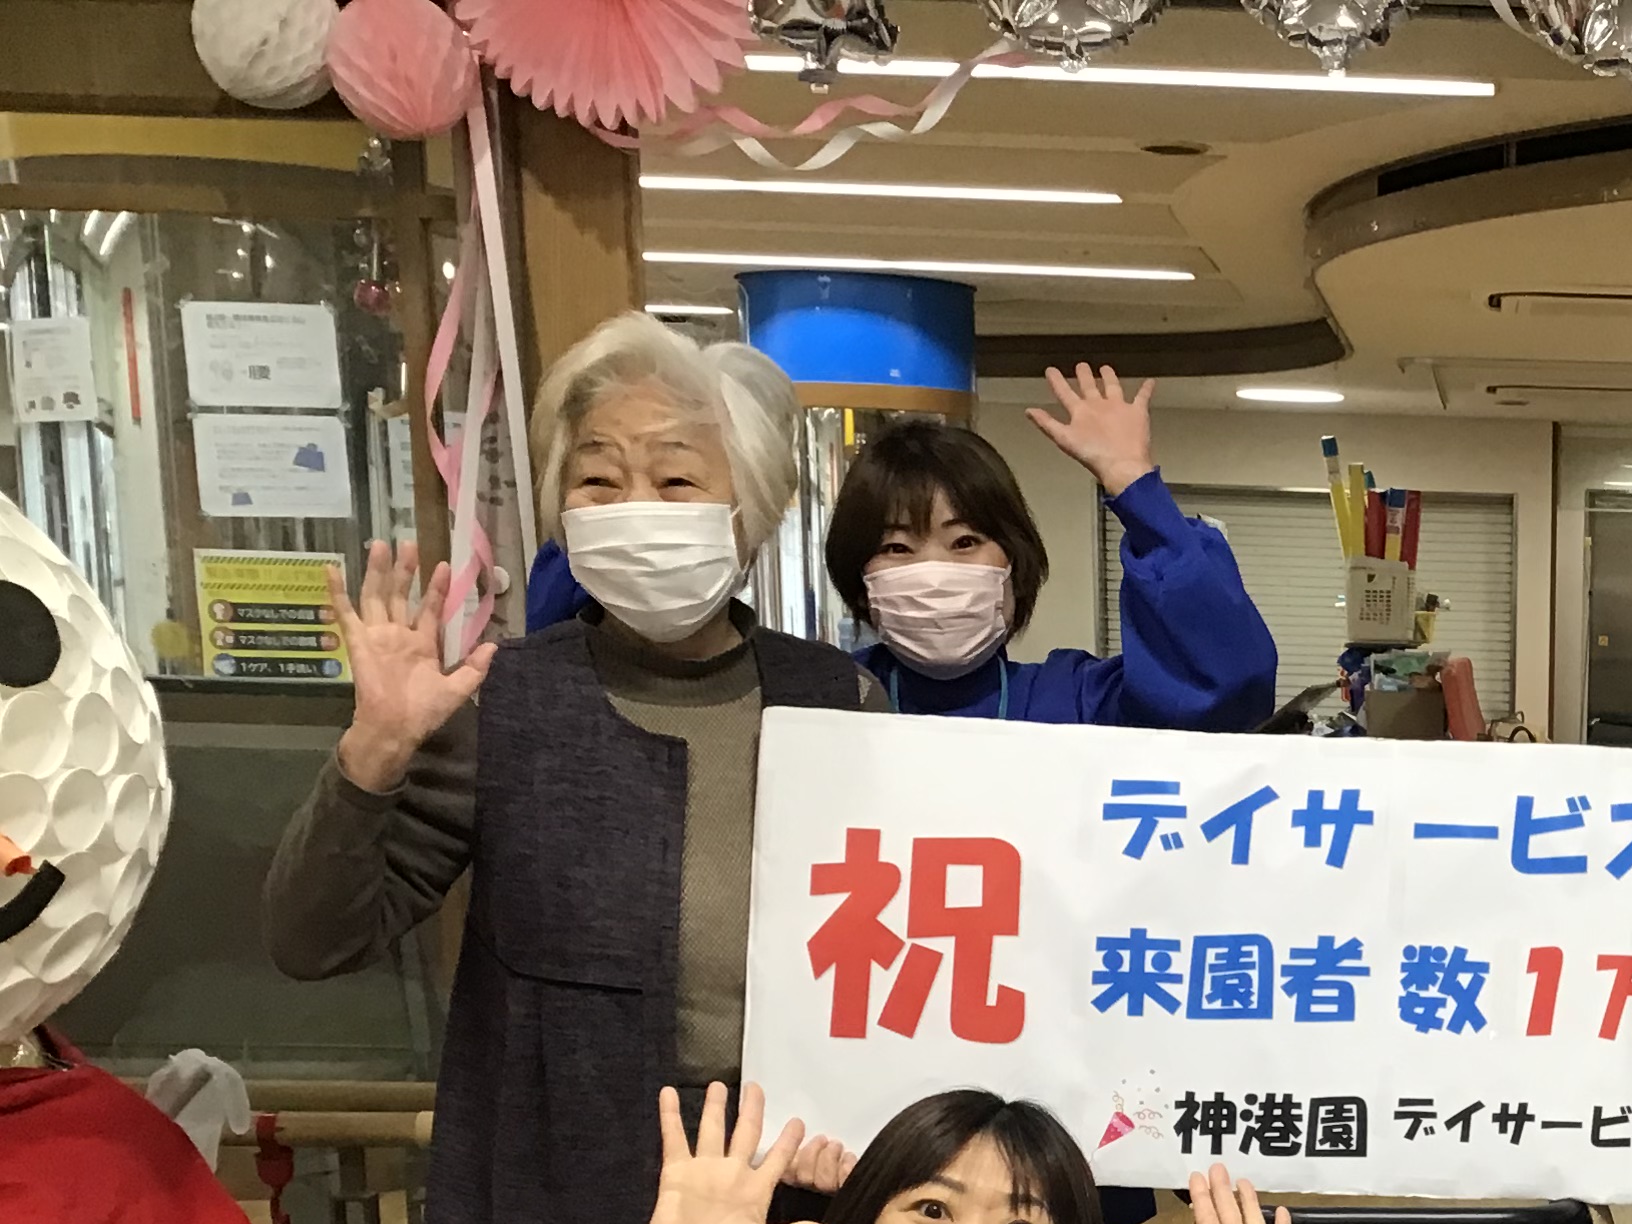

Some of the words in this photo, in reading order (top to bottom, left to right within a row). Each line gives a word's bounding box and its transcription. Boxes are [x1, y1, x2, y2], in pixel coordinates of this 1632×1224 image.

[807, 828, 1026, 1044] 祝
[1173, 1091, 1368, 1158] 神港園
